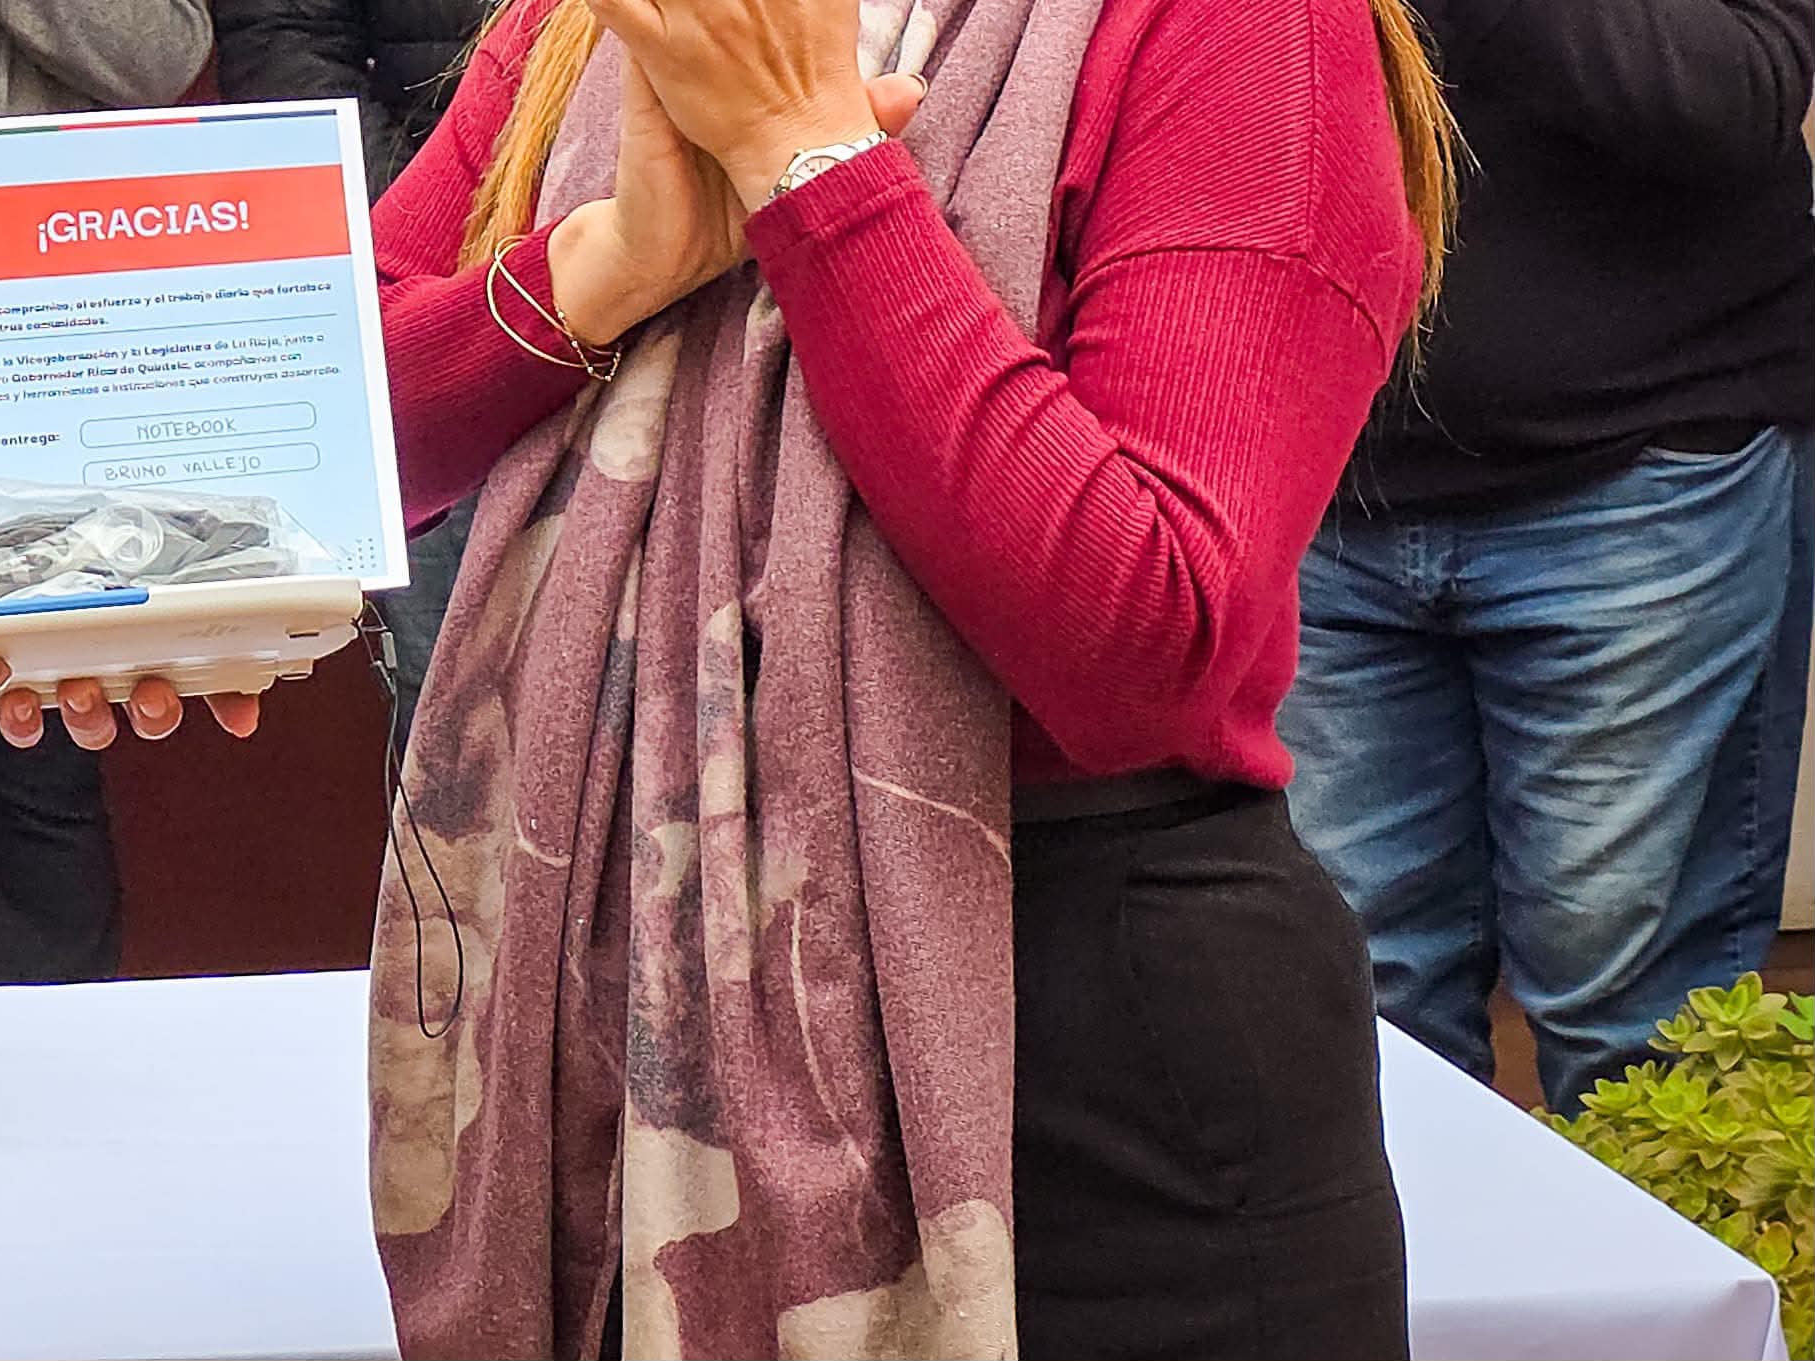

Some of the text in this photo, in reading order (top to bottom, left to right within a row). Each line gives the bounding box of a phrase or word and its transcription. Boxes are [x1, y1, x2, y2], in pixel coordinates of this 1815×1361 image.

[38, 200, 250, 253] ¡GRACIAS!
[1, 432, 60, 448] entrega:
[137, 417, 238, 440] NOTEBOOK
[105, 456, 261, 482] BRUNO VALLEJO
